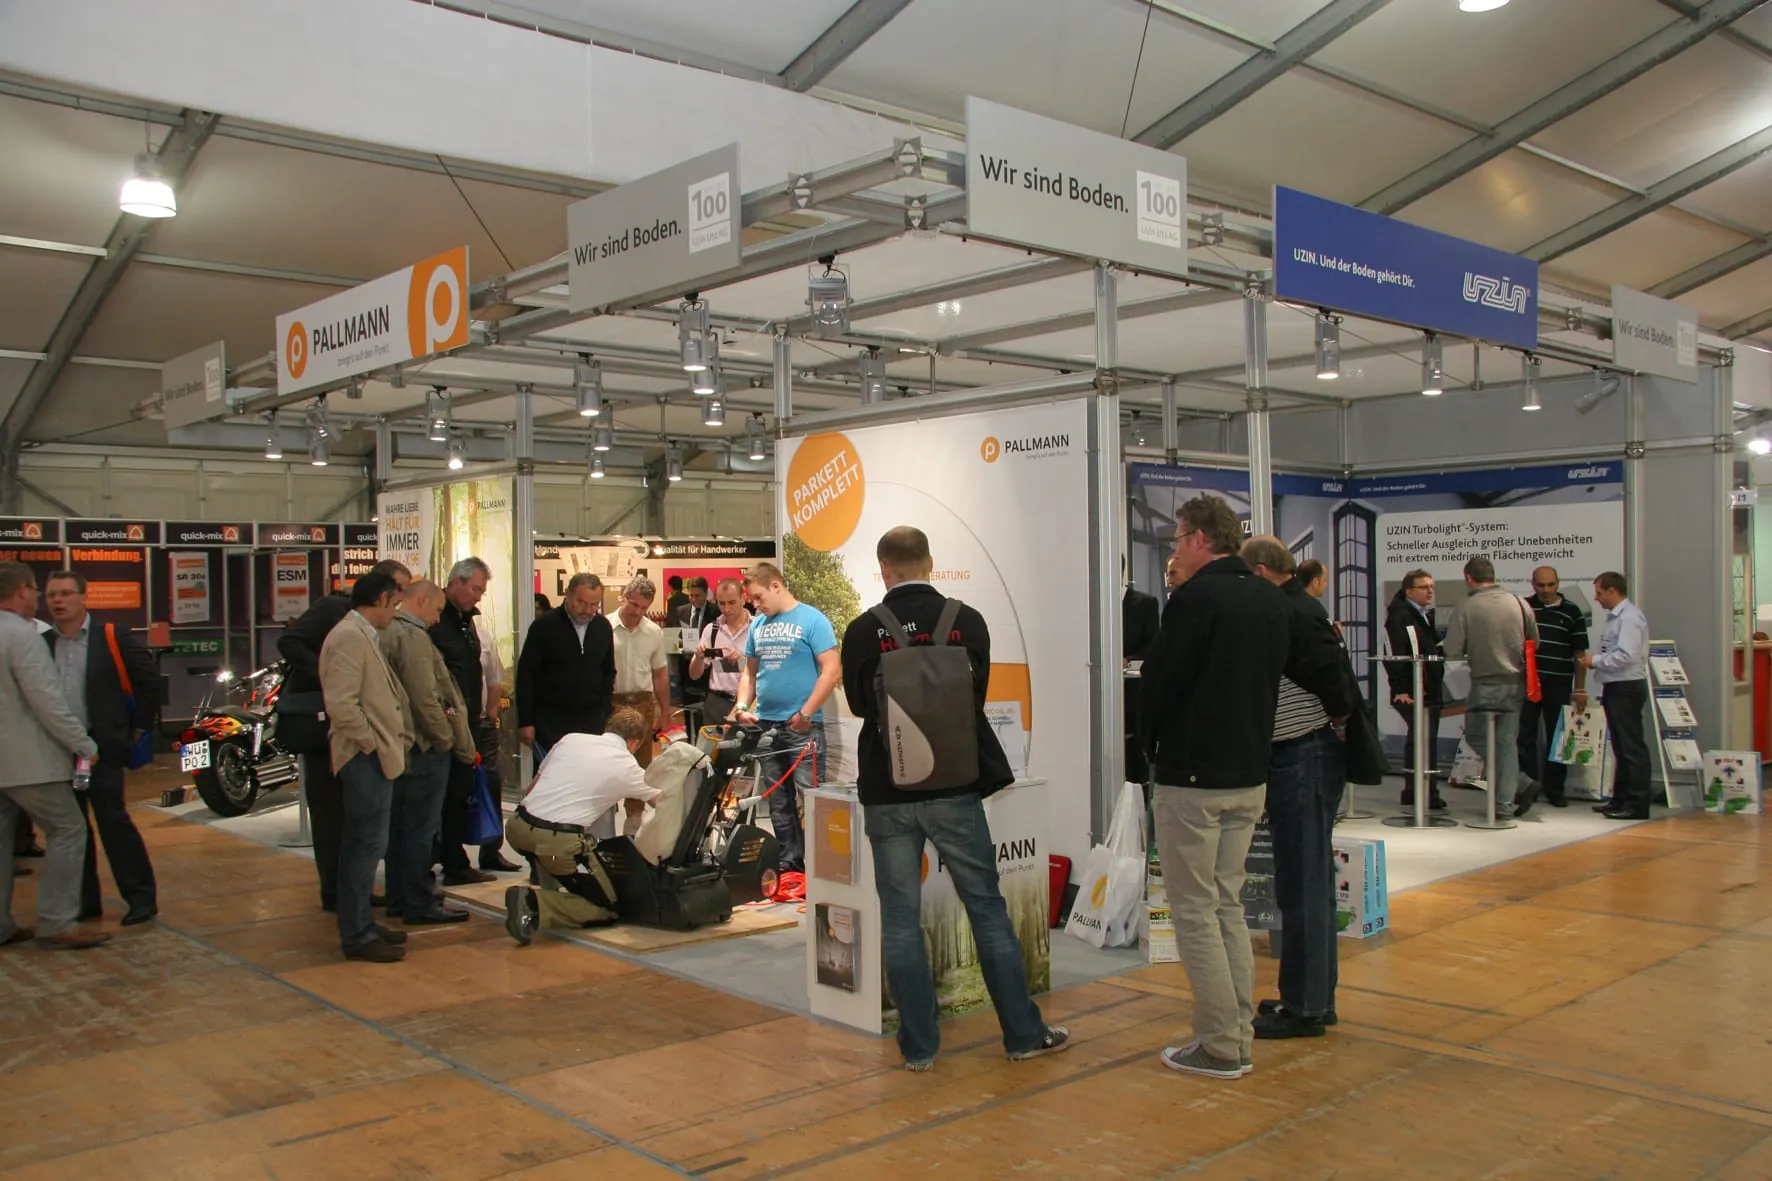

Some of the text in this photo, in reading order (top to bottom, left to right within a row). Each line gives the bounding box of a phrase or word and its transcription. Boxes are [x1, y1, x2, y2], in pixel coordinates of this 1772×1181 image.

[980, 153, 1129, 214] Wir sind Boden.
[691, 189, 727, 222] 100
[1140, 180, 1178, 218] 100
[574, 218, 682, 266] Wir sind Boden.
[1293, 247, 1416, 288] UZIN. Und der Boden gehört Dir.
[312, 304, 390, 356] PALLMANN
[1618, 319, 1633, 336] Wir
[1634, 324, 1651, 341] sind
[1004, 432, 1070, 454] PALLMANN
[793, 449, 847, 506] PARKETT
[793, 463, 860, 529] KOMPLETT
[385, 501, 419, 514] WAHRE LIEBE
[477, 499, 506, 510] PALLMANN
[81, 530, 128, 541] quick-mix
[180, 530, 223, 542] quick-mix
[271, 532, 312, 542] quick-mix
[1386, 525, 1411, 536] UZIN
[386, 531, 420, 552] IMMER
[1386, 534, 1593, 551] Schneller Ausgleich großer Unebenheiten
[71, 549, 143, 563] Verbindung.
[344, 548, 374, 560] strich
[658, 545, 747, 555] ualität für Handwerker
[1386, 548, 1575, 563] mit extrem niedrigem Flächengewicht
[276, 569, 307, 582] ESM
[931, 570, 971, 581] ERATUNG
[184, 755, 207, 769] PO 2
